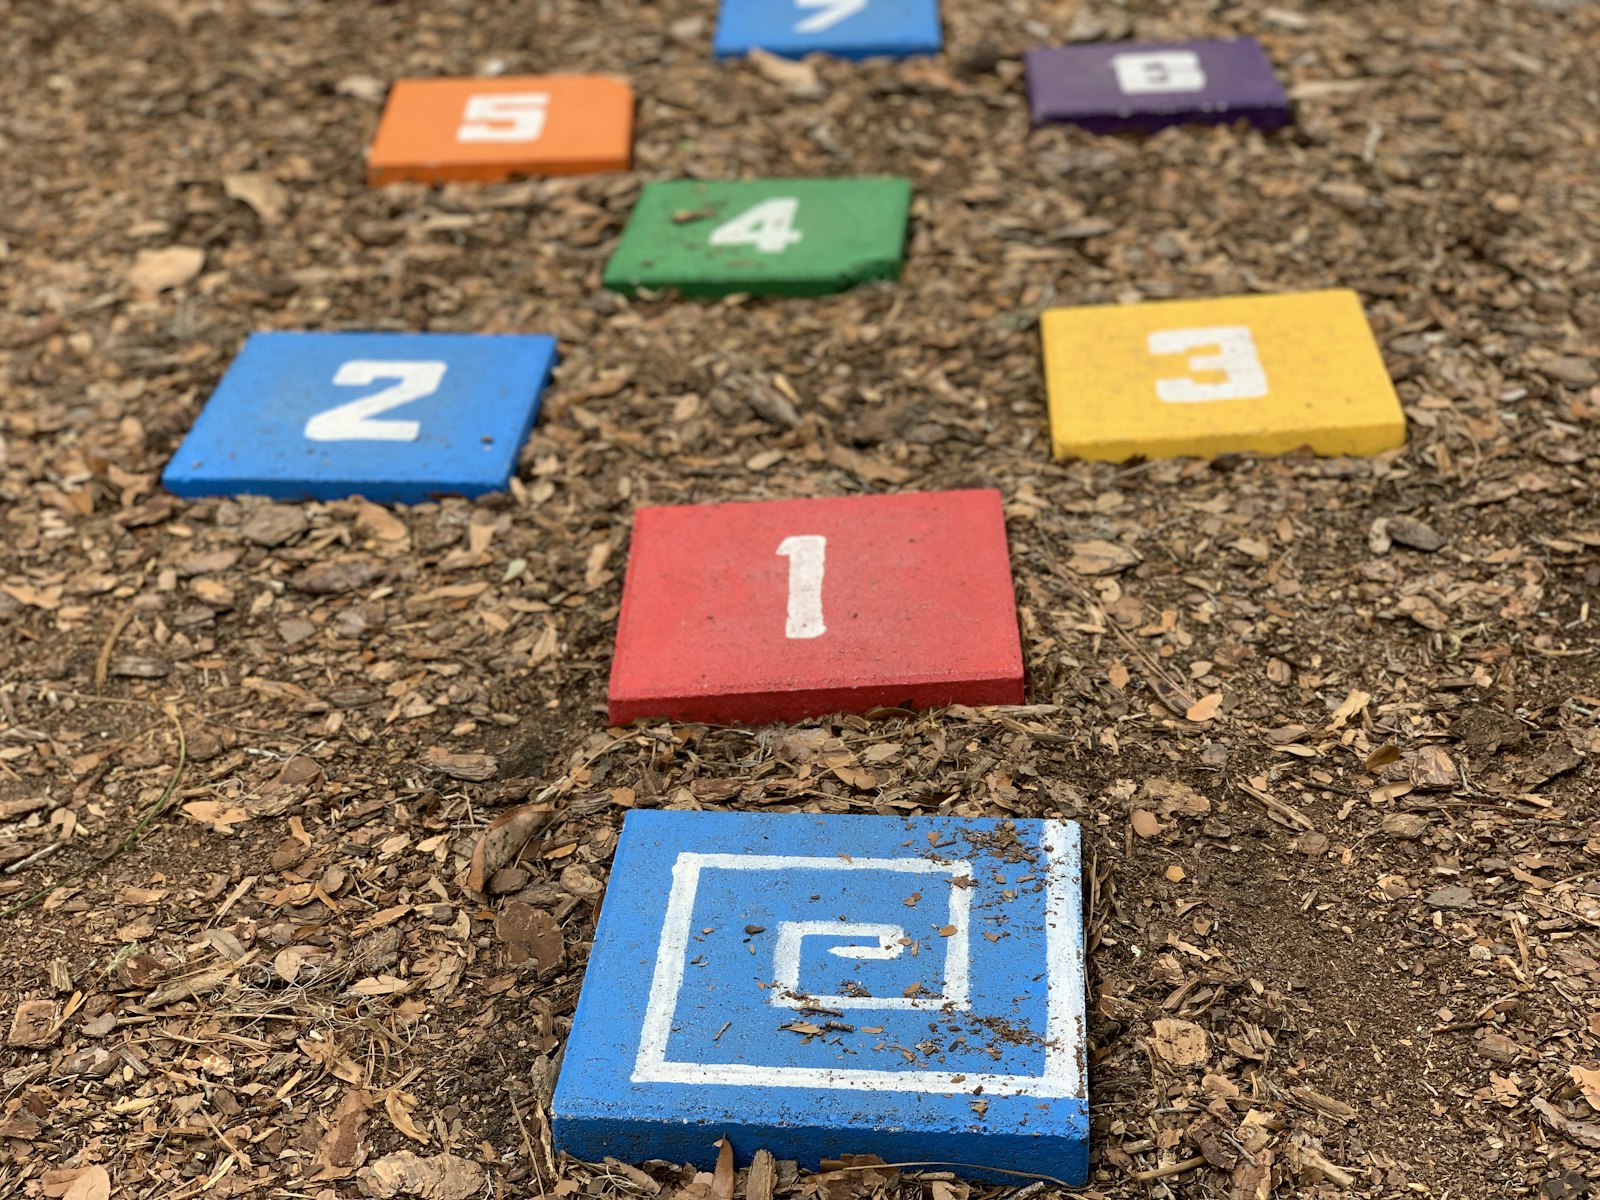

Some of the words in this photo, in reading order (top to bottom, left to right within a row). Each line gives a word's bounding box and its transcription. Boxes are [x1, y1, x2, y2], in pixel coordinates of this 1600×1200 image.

[457, 93, 549, 142] 5
[709, 197, 802, 254] 4
[304, 359, 448, 442] 2
[1147, 326, 1268, 403] 3
[776, 534, 827, 640] 1
